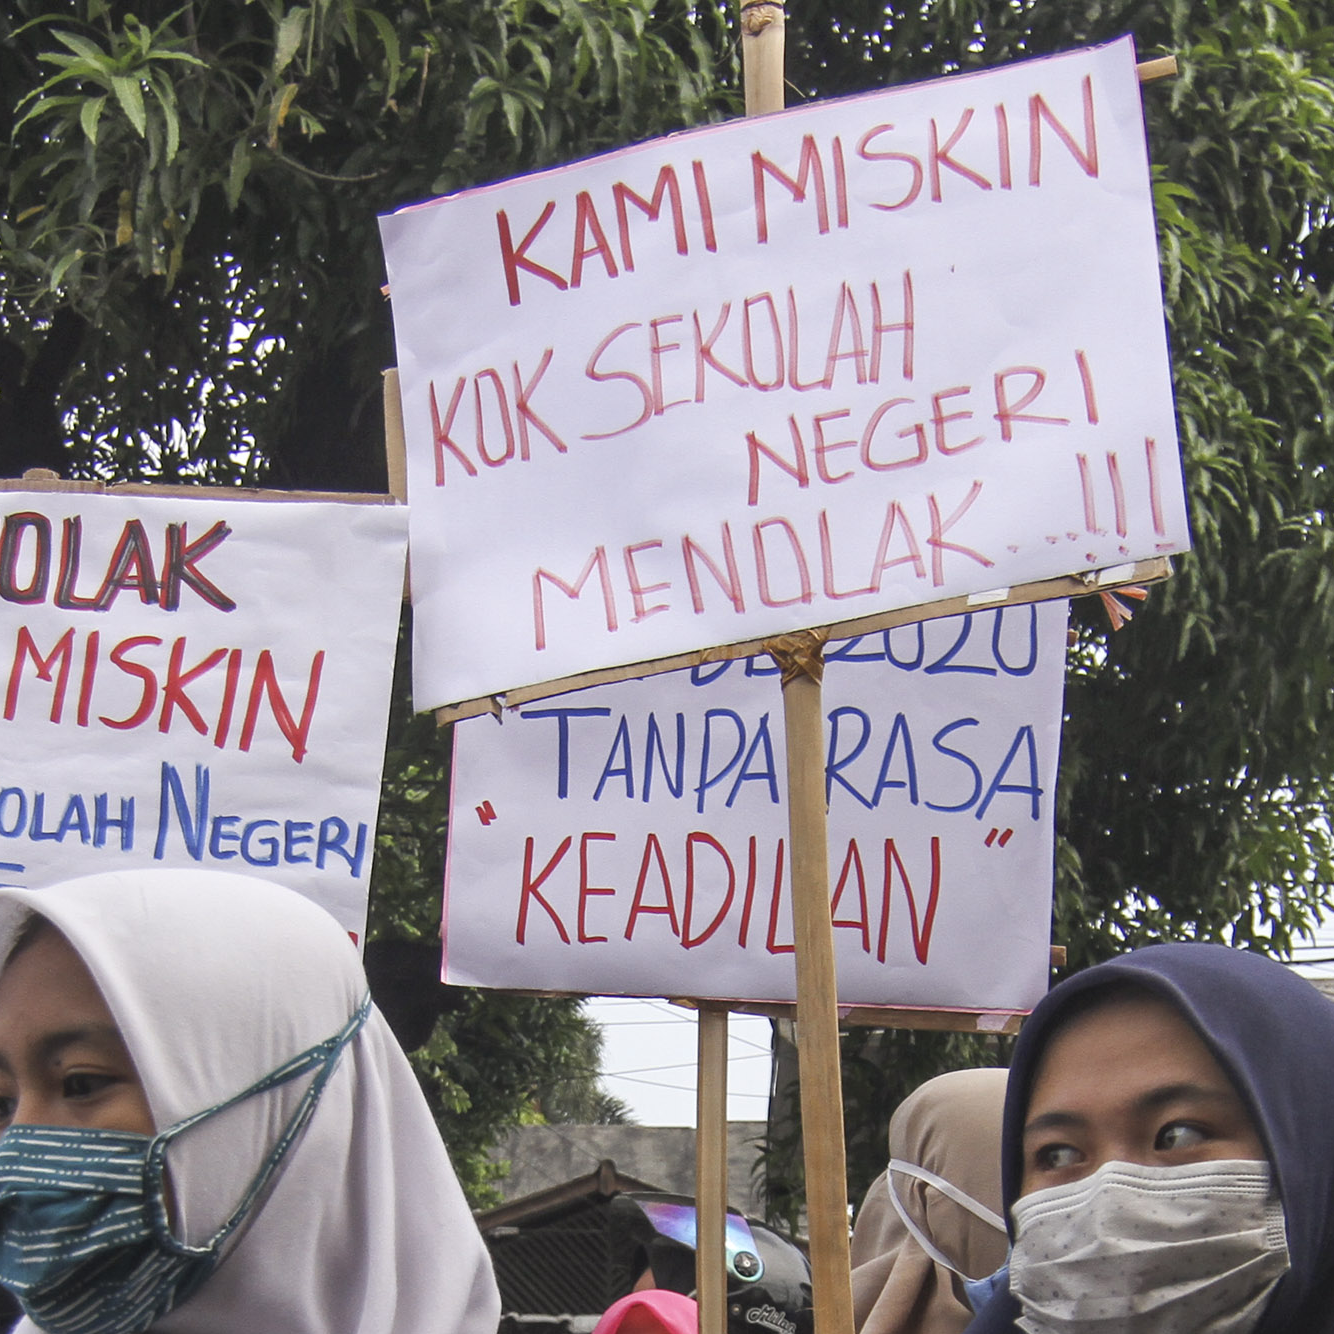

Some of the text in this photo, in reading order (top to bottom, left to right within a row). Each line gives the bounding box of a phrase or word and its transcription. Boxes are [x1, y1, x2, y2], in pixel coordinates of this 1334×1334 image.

[496, 74, 1100, 306] KAMI MISKIN
[429, 268, 915, 487] KOK SEKOLAH
[746, 348, 1102, 506] NEGERI
[3, 625, 325, 764] MISKIN
[520, 706, 1044, 821] TANPA RASA
